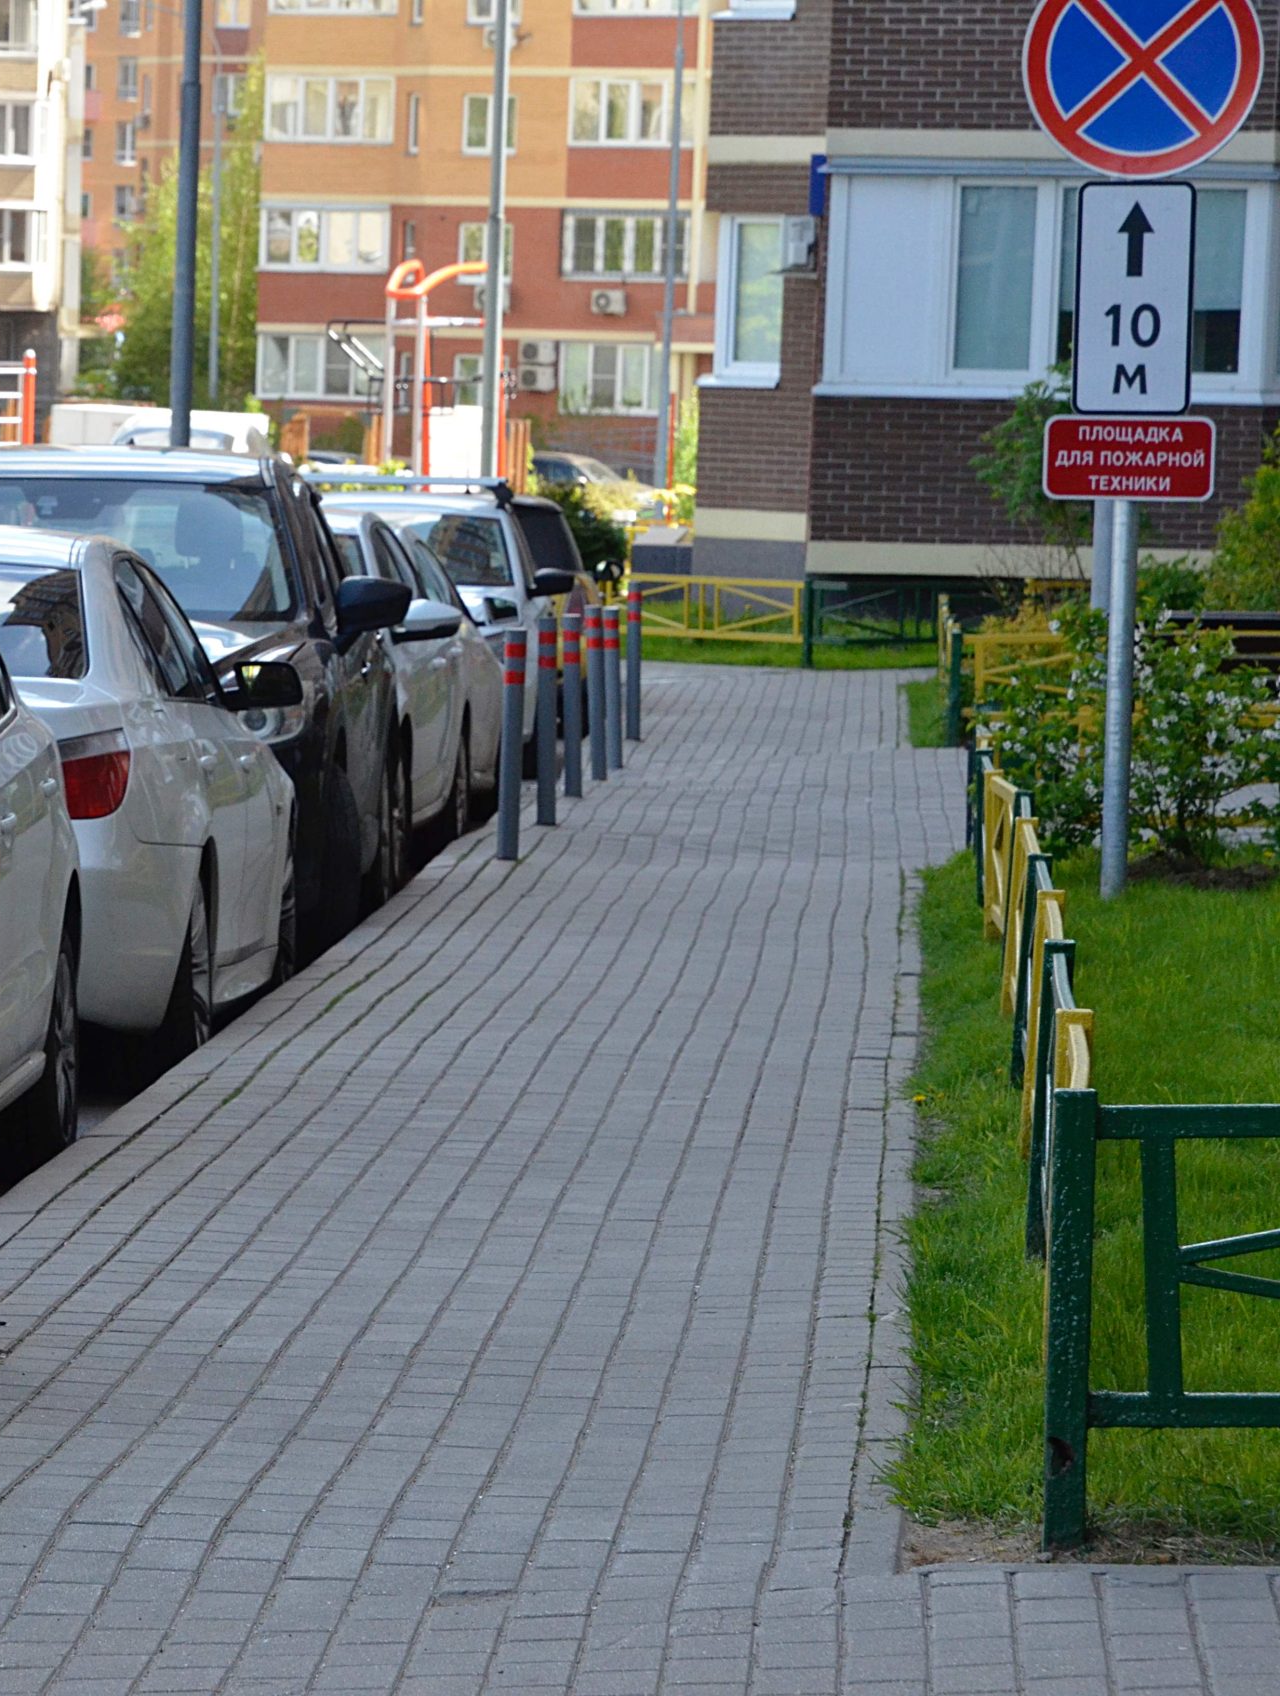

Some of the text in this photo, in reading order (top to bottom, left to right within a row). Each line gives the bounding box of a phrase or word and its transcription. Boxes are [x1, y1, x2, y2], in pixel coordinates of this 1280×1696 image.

[1103, 303, 1161, 348] 10
[1112, 363, 1148, 395] М
[1077, 425, 1184, 444] ПЛОЩАДКА
[1054, 448, 1206, 468] ДЛЯ ПОЖАРНОЙ
[1087, 474, 1171, 492] ТЕХНИКИ
